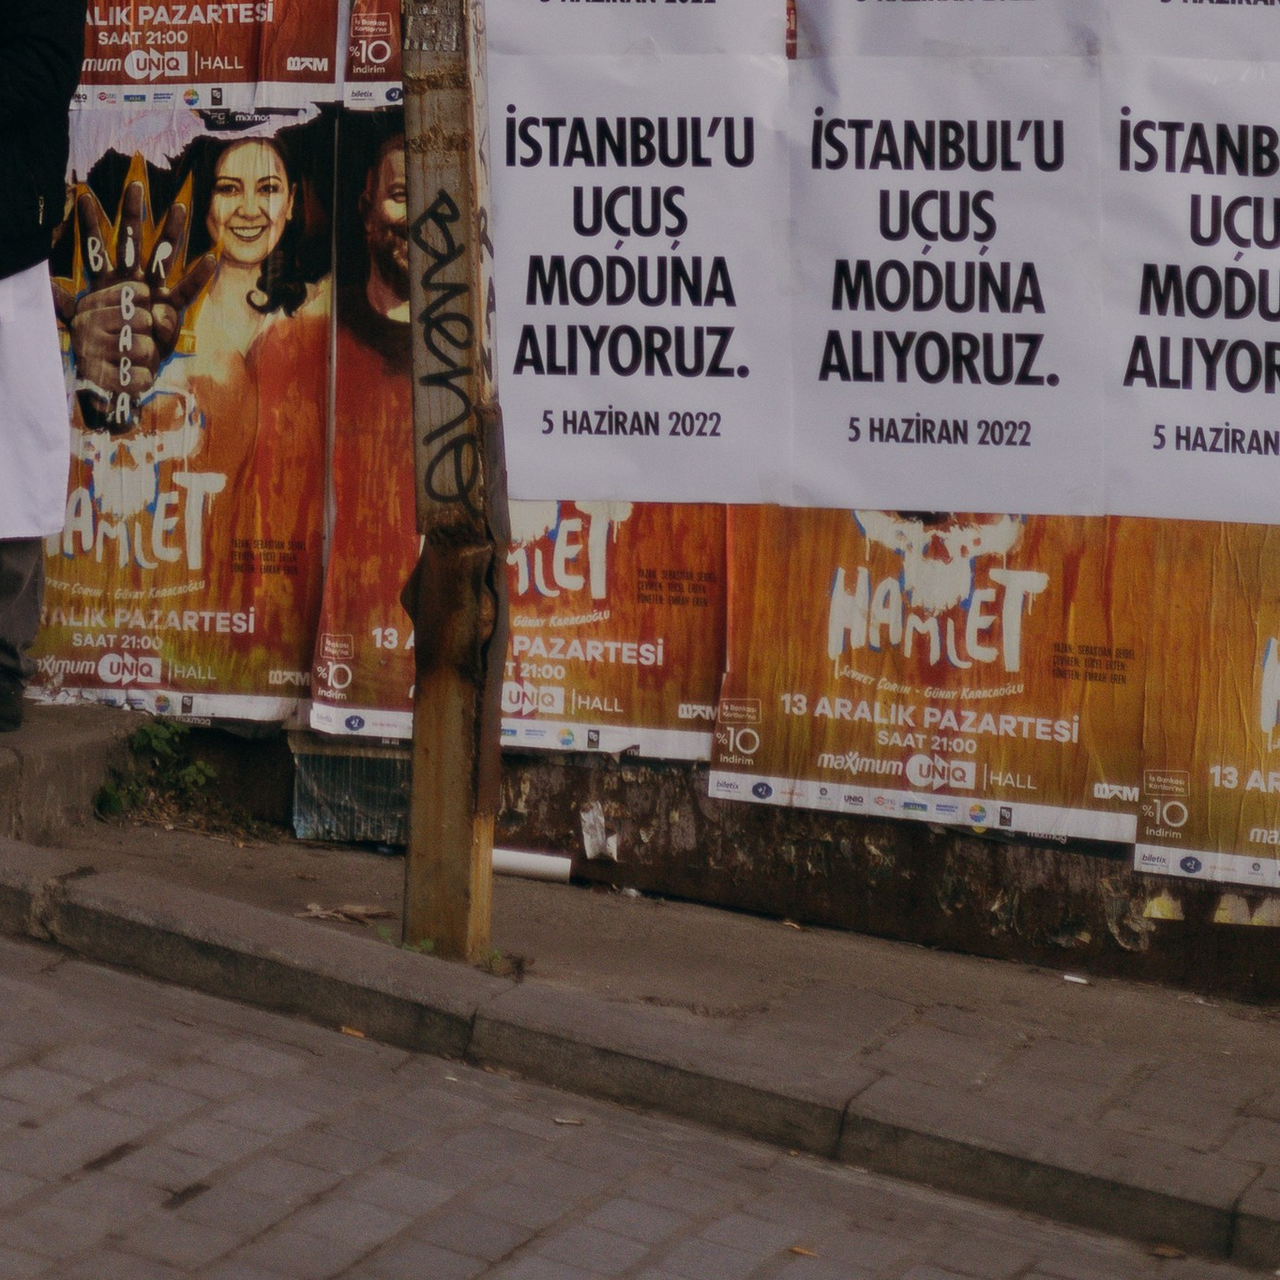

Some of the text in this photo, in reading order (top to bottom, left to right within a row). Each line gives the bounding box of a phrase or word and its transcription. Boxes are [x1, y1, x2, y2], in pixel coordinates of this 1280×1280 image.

[505, 103, 755, 168] İSTANBUL'U
[811, 105, 1064, 173] İSTANBUL'U
[573, 185, 688, 250] UÇUŞ
[879, 189, 997, 257] UÇUŞ
[526, 254, 737, 307] MODUNA
[832, 258, 1046, 314] MODUNA
[513, 324, 750, 379] ALIYORUZ.
[818, 329, 1060, 387] ALIYORUZ.
[541, 403, 722, 438] 5 HAZİRAN 2022
[848, 412, 1032, 447] 5 HAZİRAN 2022
[512, 637, 665, 667] PAZARTESİ
[781, 693, 808, 717] 13
[715, 726, 760, 755] %10
[719, 753, 754, 766] indirim
[1209, 765, 1239, 789] 13
[1145, 826, 1182, 839] indirim
